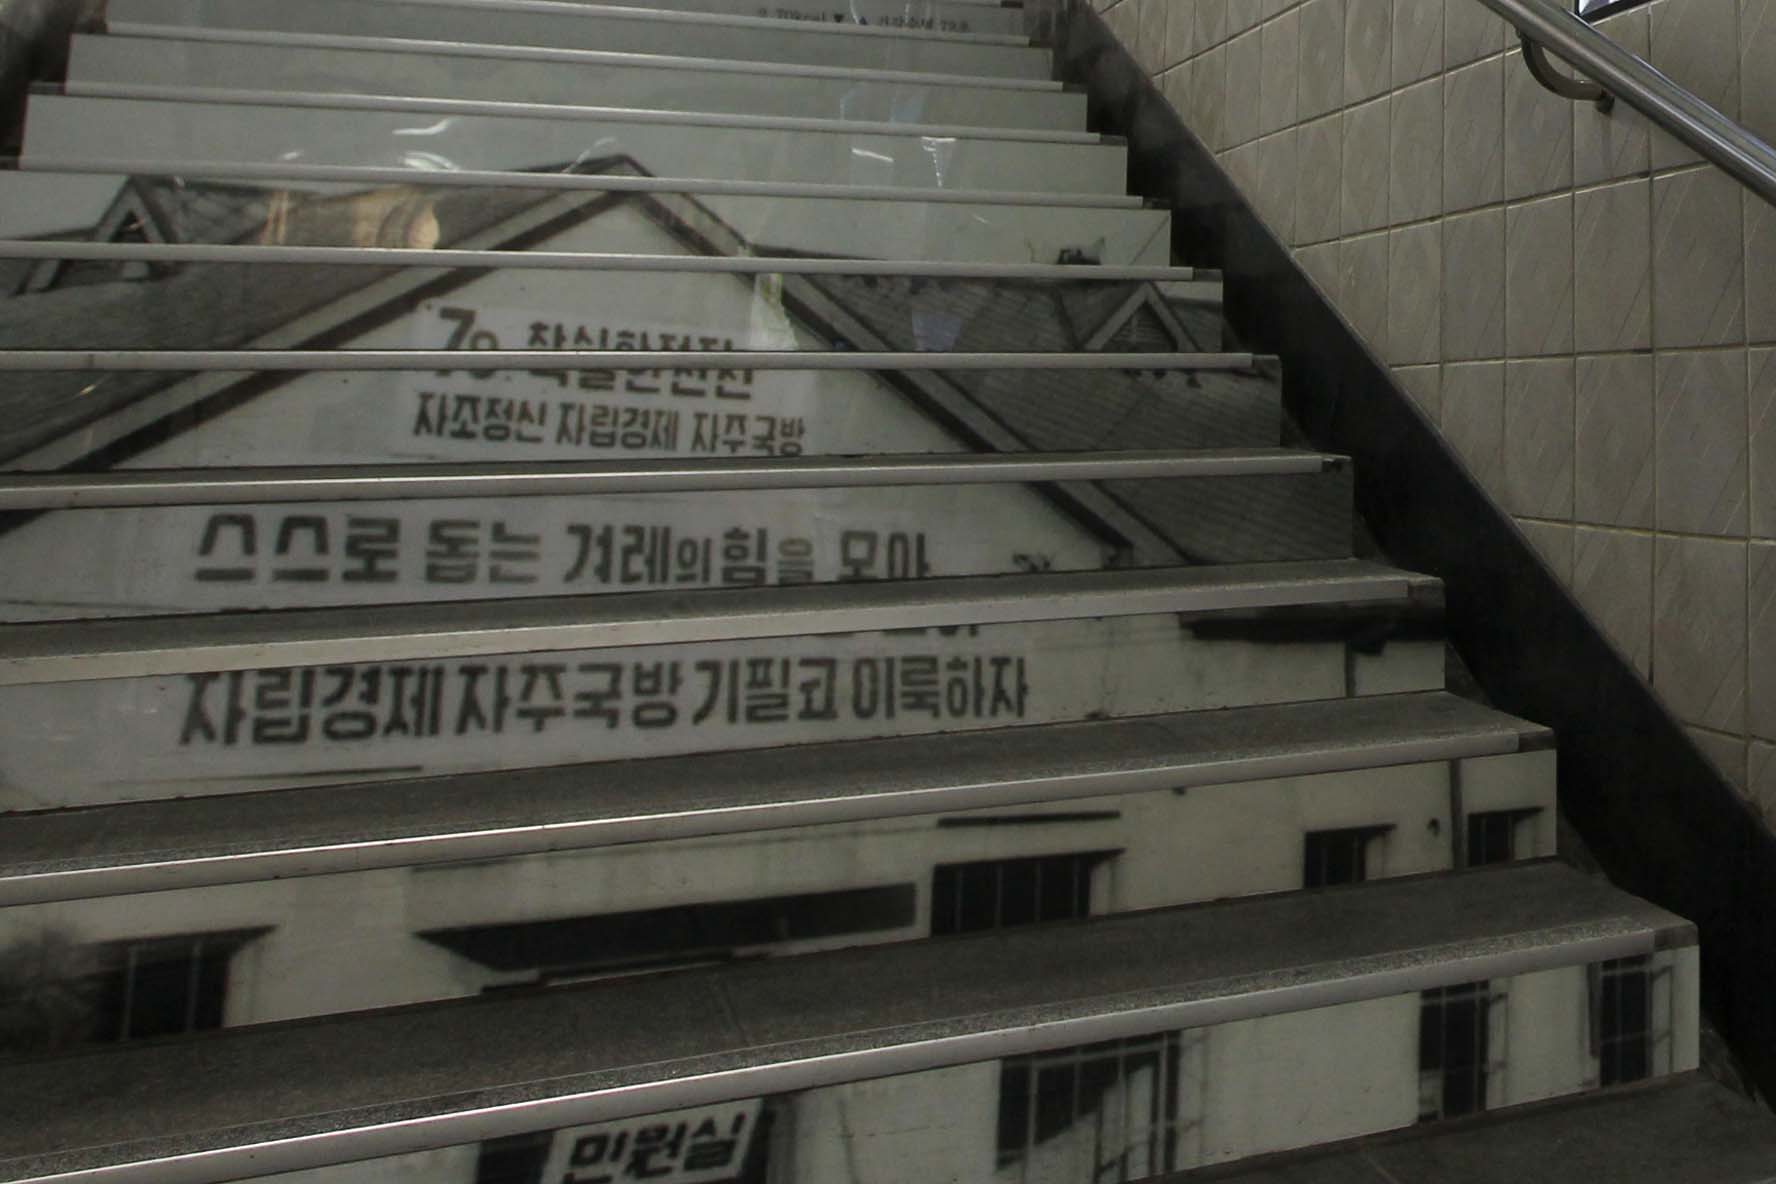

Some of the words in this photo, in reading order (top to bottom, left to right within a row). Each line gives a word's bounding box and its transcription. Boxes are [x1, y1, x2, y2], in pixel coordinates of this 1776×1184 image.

[413, 392, 547, 444] 자조정신
[555, 401, 680, 453] 자립경제
[690, 412, 807, 457] 자주국방
[194, 513, 402, 584] 스스로
[424, 519, 542, 584] 돕는
[562, 524, 712, 585] 겨레의
[721, 525, 816, 585] 힘을
[180, 671, 445, 747] 자립경제
[455, 660, 685, 735] 자주국방
[690, 657, 839, 726] 기필코
[851, 654, 1030, 720] 이룩하자
[563, 1112, 747, 1184] 민원실
